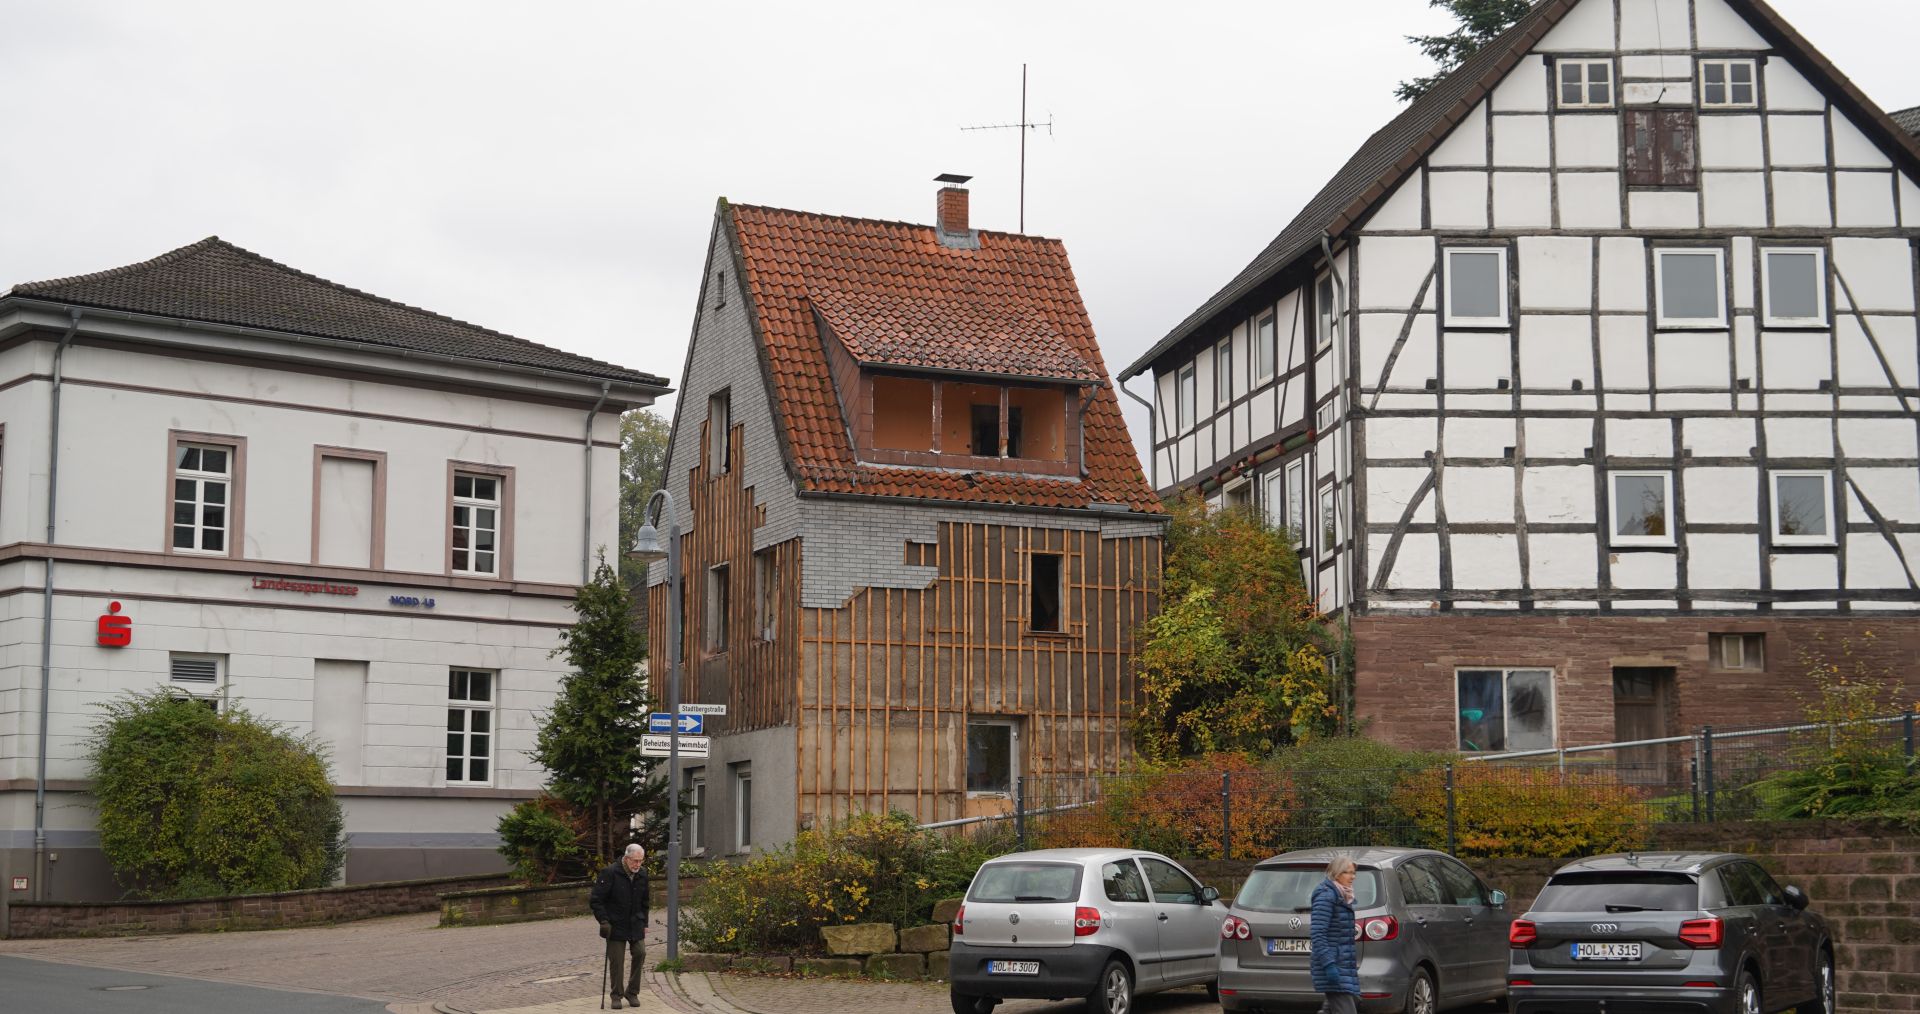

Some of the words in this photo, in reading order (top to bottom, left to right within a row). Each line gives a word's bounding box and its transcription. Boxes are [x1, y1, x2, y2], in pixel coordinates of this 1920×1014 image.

[252, 576, 359, 596] Landessparkasse
[682, 705, 724, 713] Stadtbergstraße
[643, 739, 671, 748] Beheiztes
[678, 740, 708, 749] hwimmbad
[1274, 940, 1290, 951] HOL
[1296, 940, 1307, 951] FK
[1578, 944, 1600, 956] HOL
[1608, 945, 1615, 956] X
[1617, 945, 1639, 956] 315
[992, 961, 1007, 972] HOL
